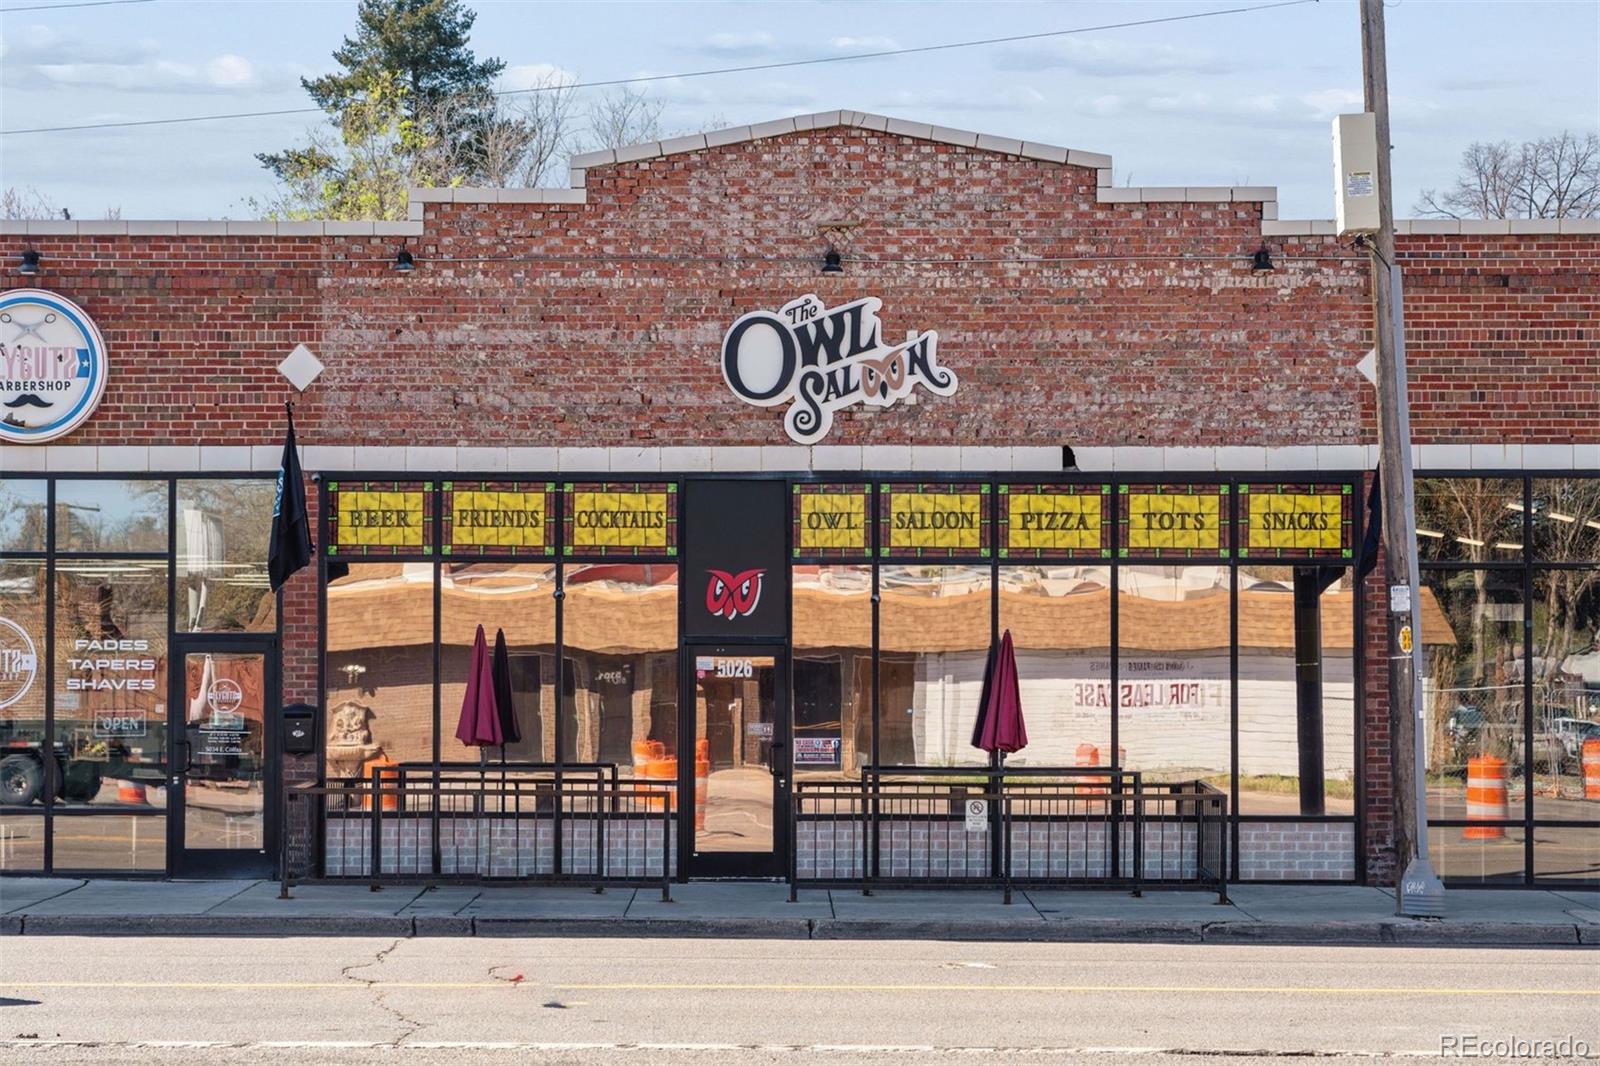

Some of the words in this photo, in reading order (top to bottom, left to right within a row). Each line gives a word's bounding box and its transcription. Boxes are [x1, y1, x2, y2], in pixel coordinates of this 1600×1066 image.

[785, 298, 818, 325] The
[350, 509, 412, 528] BEER
[458, 509, 540, 528] FRIENDS
[577, 510, 664, 529] COCKTAILS
[807, 511, 858, 529] OWL
[895, 511, 975, 530] SALOON
[1020, 511, 1090, 530] PIZZA
[1143, 511, 1205, 530] TOTS
[1262, 512, 1329, 531] SNACKS
[75, 639, 149, 651] FADES
[67, 659, 156, 671] TAPERS
[717, 660, 753, 678] 5026
[66, 678, 156, 690] SHAVES
[102, 716, 139, 731] OPEN
